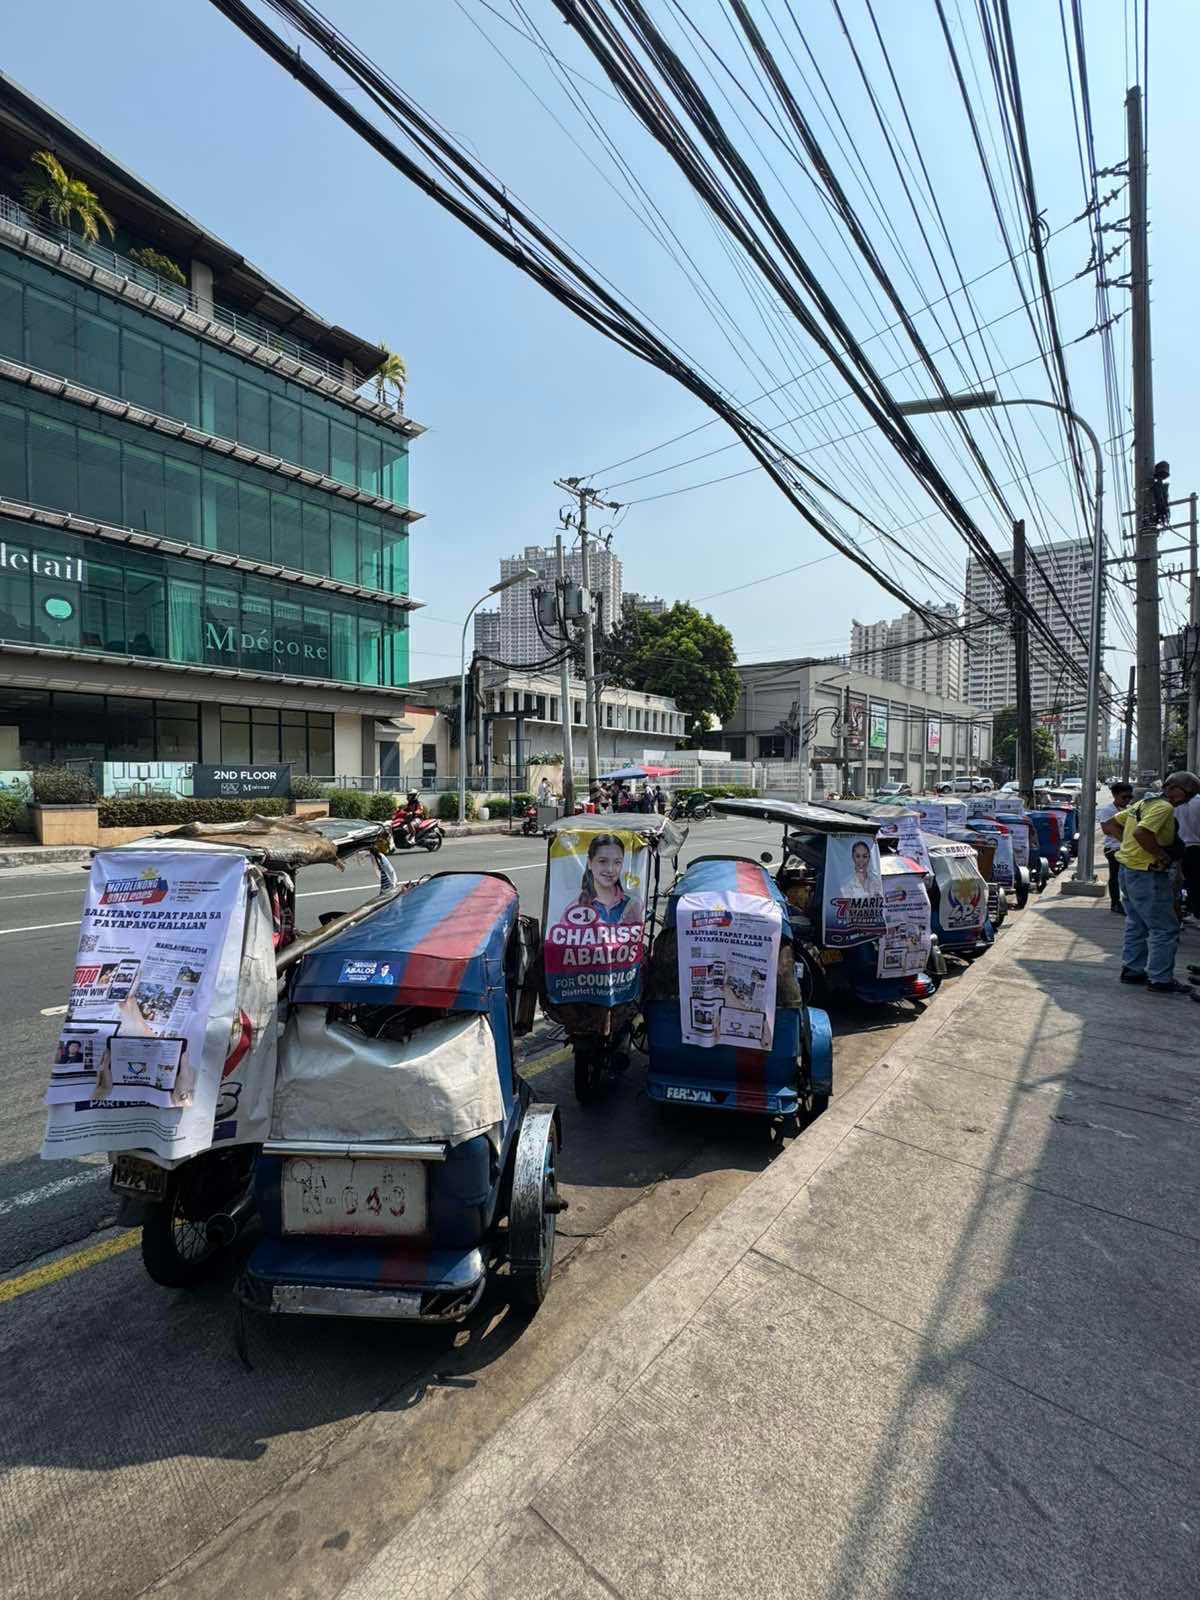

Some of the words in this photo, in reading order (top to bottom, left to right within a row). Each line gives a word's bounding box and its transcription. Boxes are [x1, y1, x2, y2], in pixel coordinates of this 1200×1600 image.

[214, 770, 238, 780] 2ND
[240, 771, 277, 780] FLOOR
[142, 911, 180, 919] TAPAT
[179, 911, 208, 919] PARA
[208, 911, 222, 919] SA
[583, 910, 591, 922] 1
[92, 919, 158, 929] PAYAPANG
[156, 921, 208, 930] HALALAN
[552, 926, 642, 945] CHARISS
[563, 945, 638, 966] ABALOS
[556, 978, 575, 988] FOR
